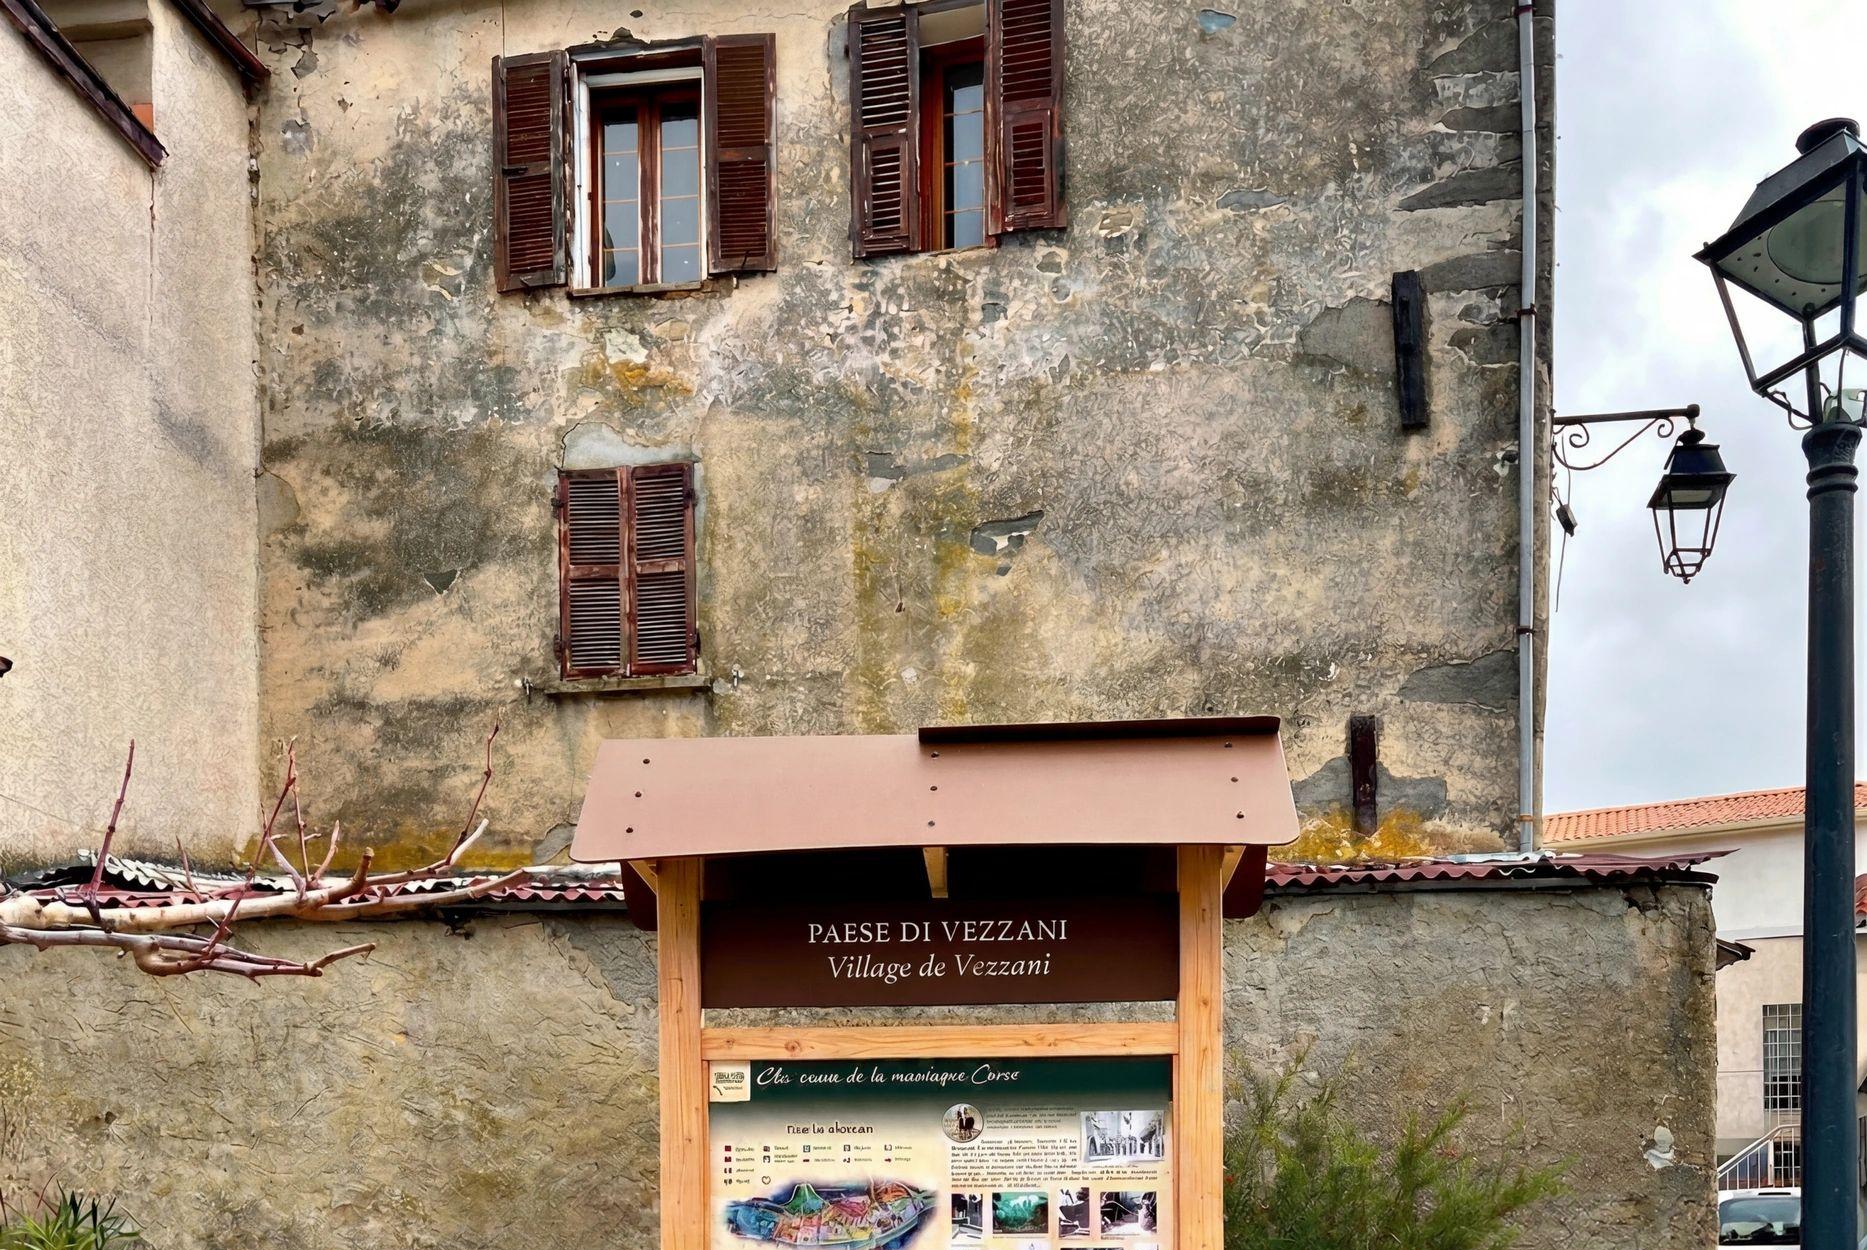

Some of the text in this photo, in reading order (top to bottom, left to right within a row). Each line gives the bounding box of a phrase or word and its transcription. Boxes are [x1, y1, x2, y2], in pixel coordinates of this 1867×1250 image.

[808, 919, 1068, 944] PAESE DI VEZZANI
[828, 952, 1051, 985] Village de Vezzani
[846, 1066, 867, 1083] de
[871, 1066, 887, 1083] la
[971, 1063, 1020, 1085] Corse
